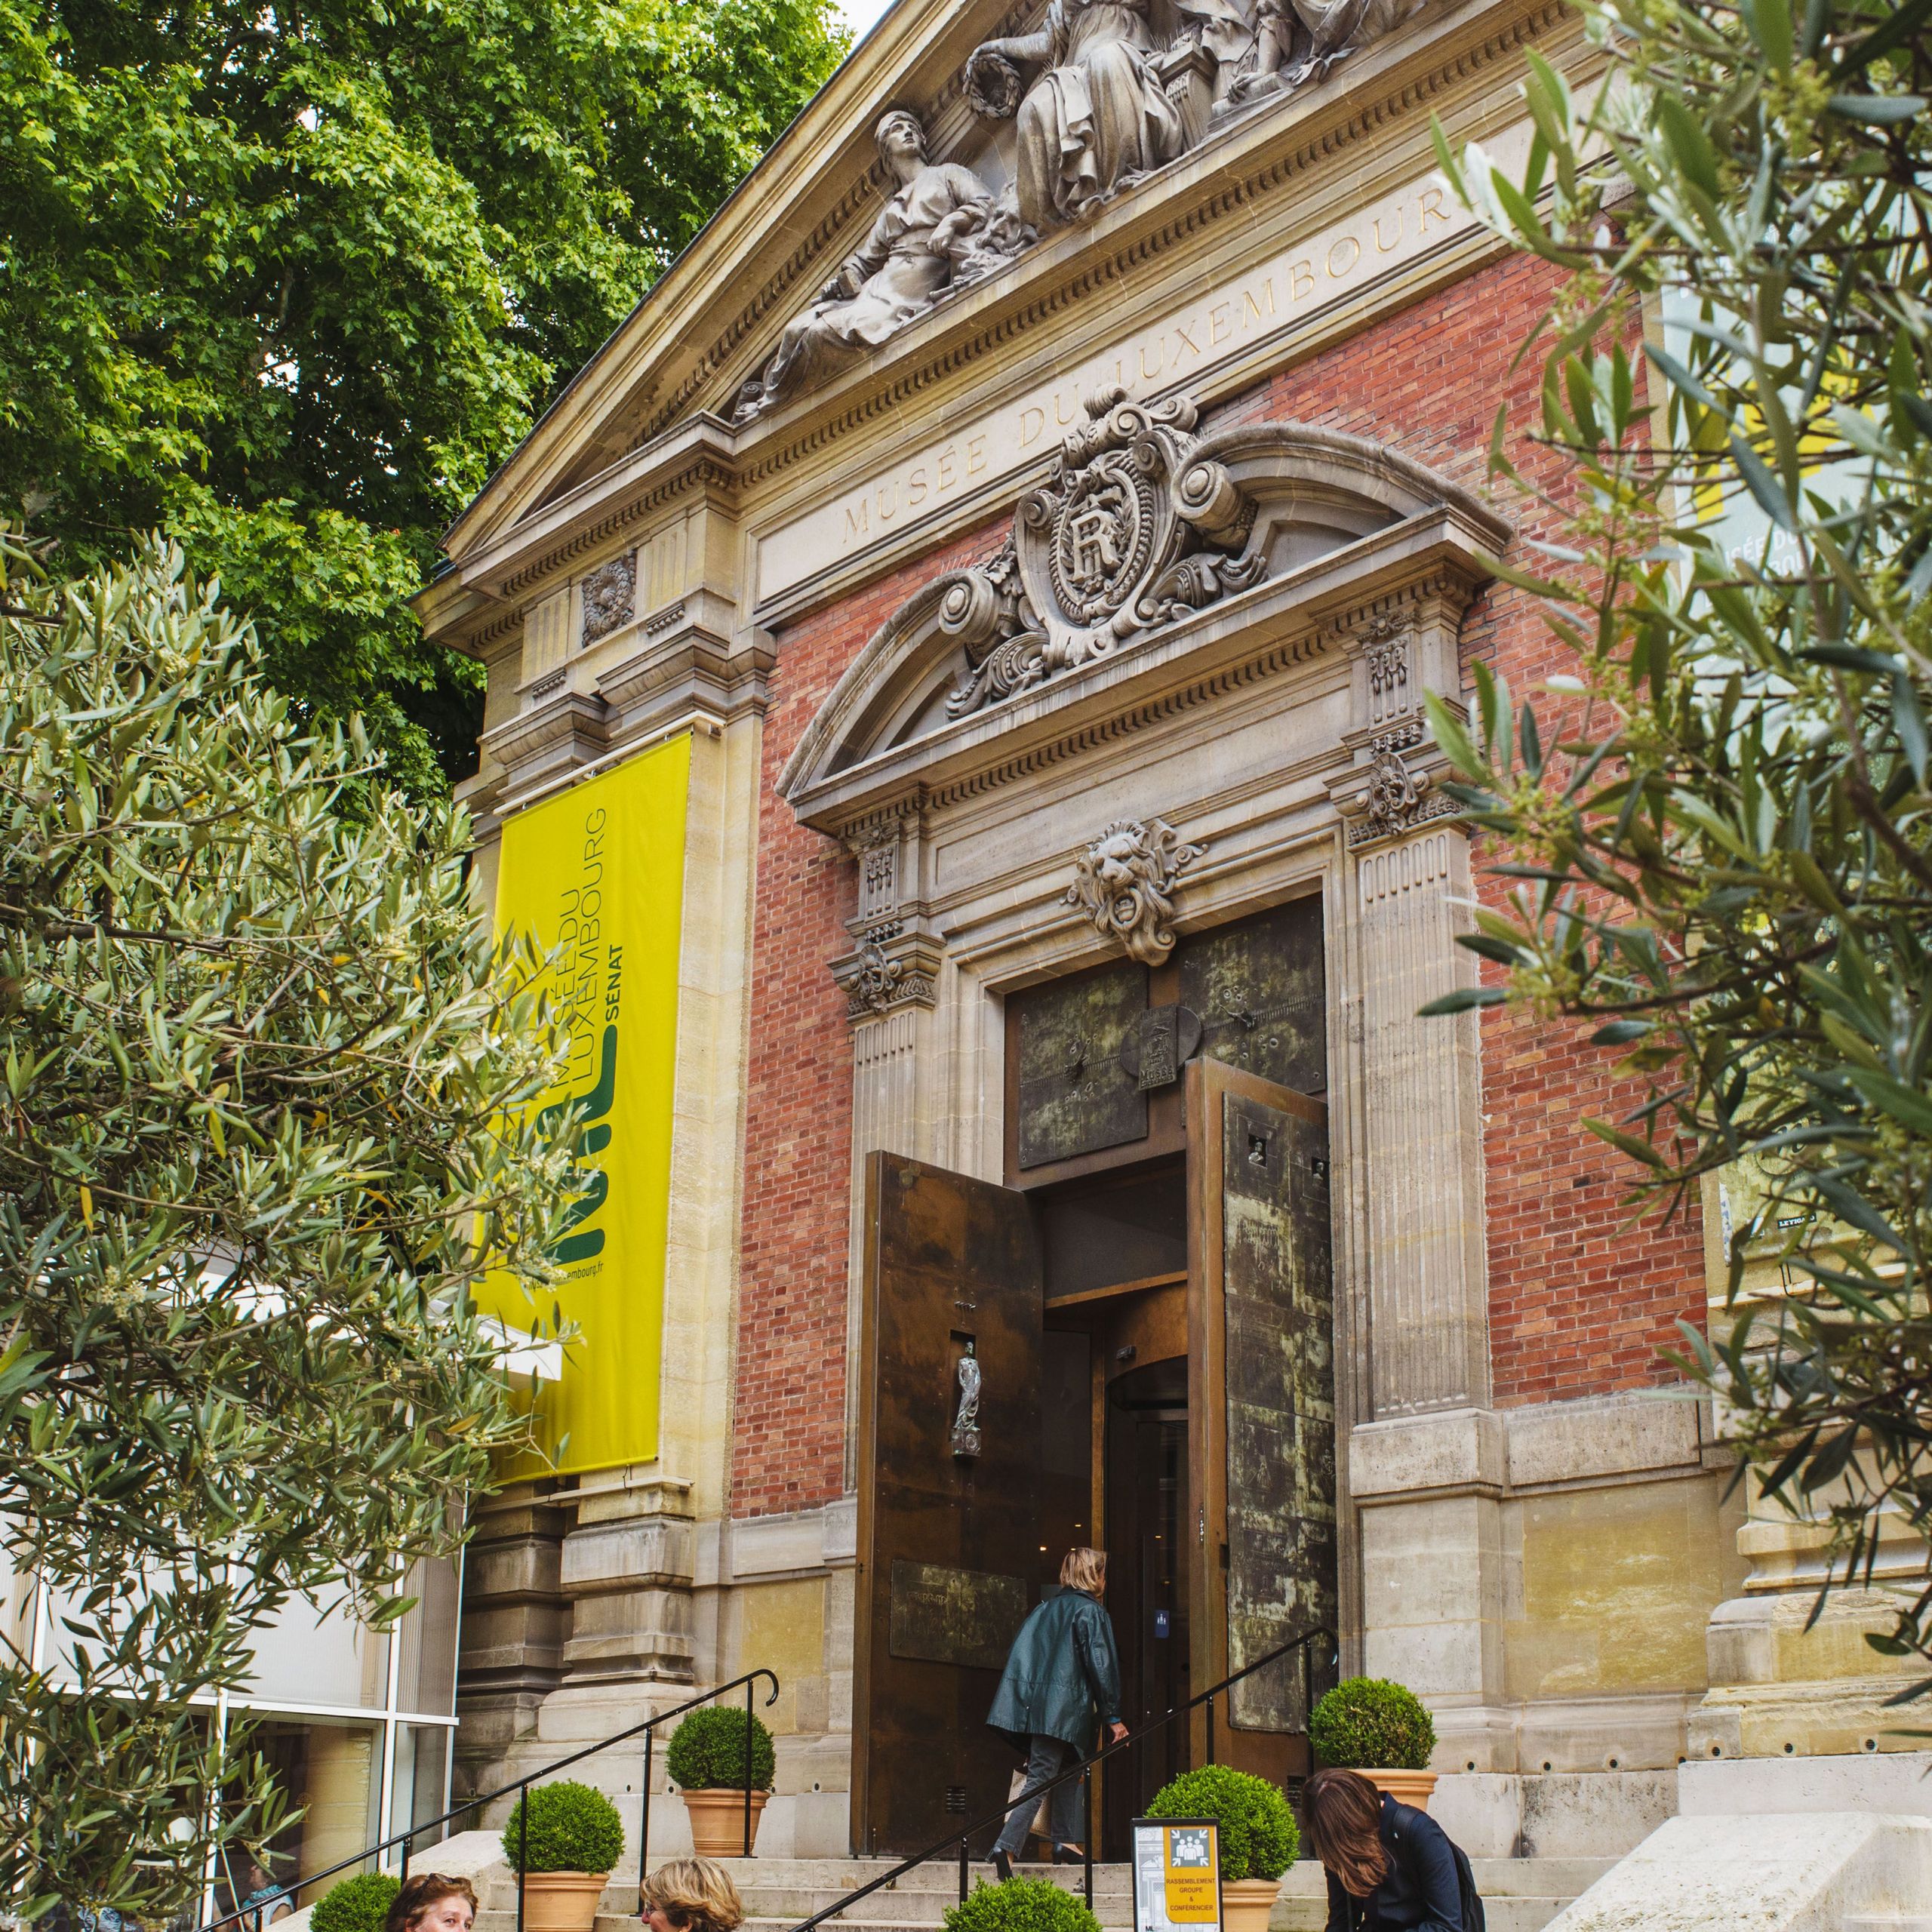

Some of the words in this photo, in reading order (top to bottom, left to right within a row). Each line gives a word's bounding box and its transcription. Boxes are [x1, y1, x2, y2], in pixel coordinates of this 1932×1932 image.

[843, 435, 987, 543] MUSÉE
[1019, 398, 1079, 450] DU
[1115, 169, 1480, 390] LUXEMBOUR
[558, 889, 580, 945] DU
[571, 808, 606, 1081] LUXEMBOURG
[605, 944, 623, 1022] SÉNAT
[1789, 1215, 1815, 1226] FIGAO
